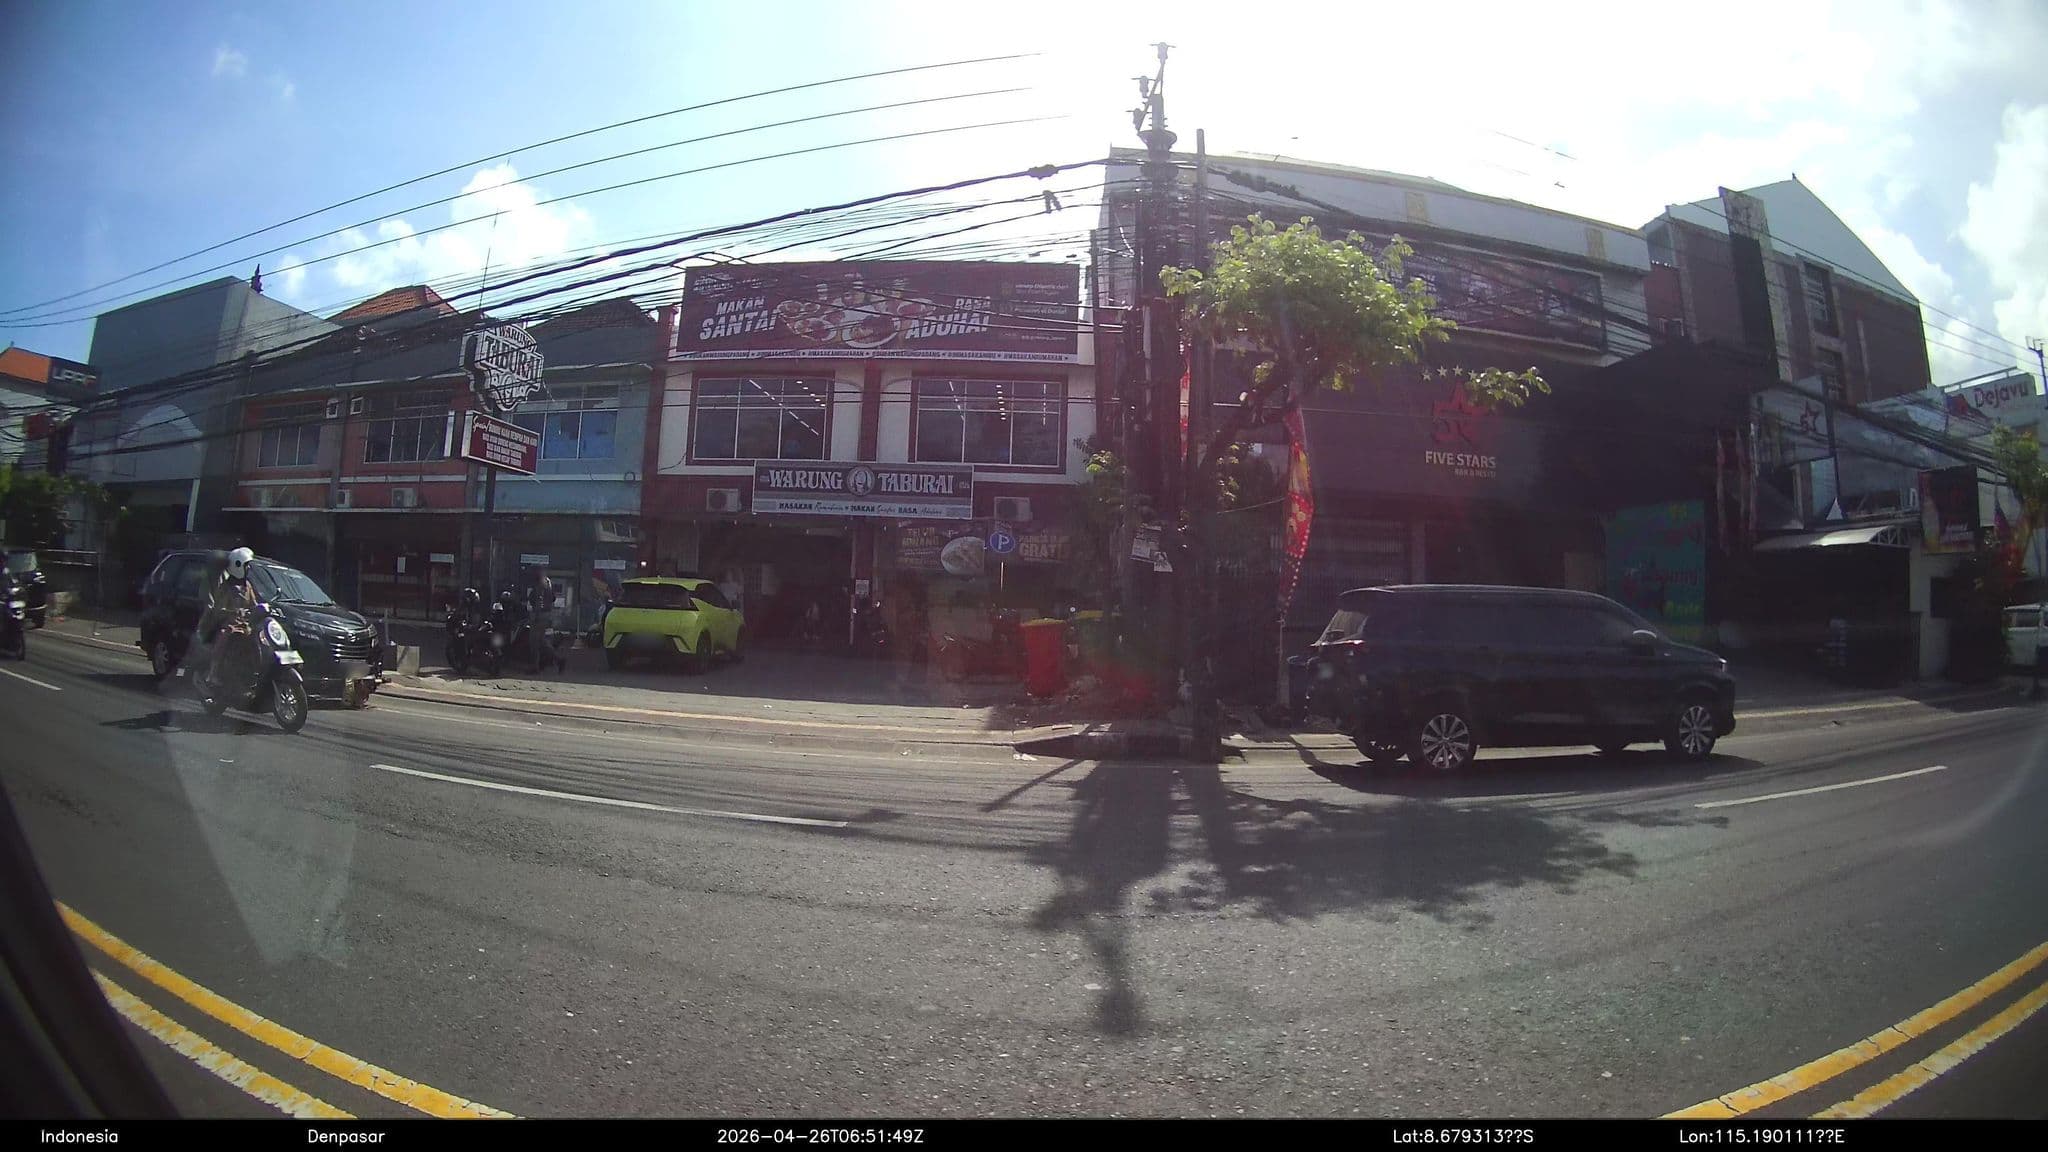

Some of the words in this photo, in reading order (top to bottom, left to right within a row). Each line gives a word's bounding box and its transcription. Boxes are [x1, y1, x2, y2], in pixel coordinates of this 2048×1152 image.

[716, 297, 766, 316] MAKAN
[699, 309, 778, 341] SANTAI
[905, 311, 992, 340] ADUHAI
[485, 336, 541, 381] TABURAI
[1973, 382, 2029, 408] Dejavu
[1425, 451, 1456, 466] FIVE
[1456, 454, 1497, 469] STARS
[768, 469, 843, 490] WARUNG
[877, 472, 954, 495] TABURAI
[778, 502, 813, 510] MASAKAN
[850, 504, 875, 513] MAKAN
